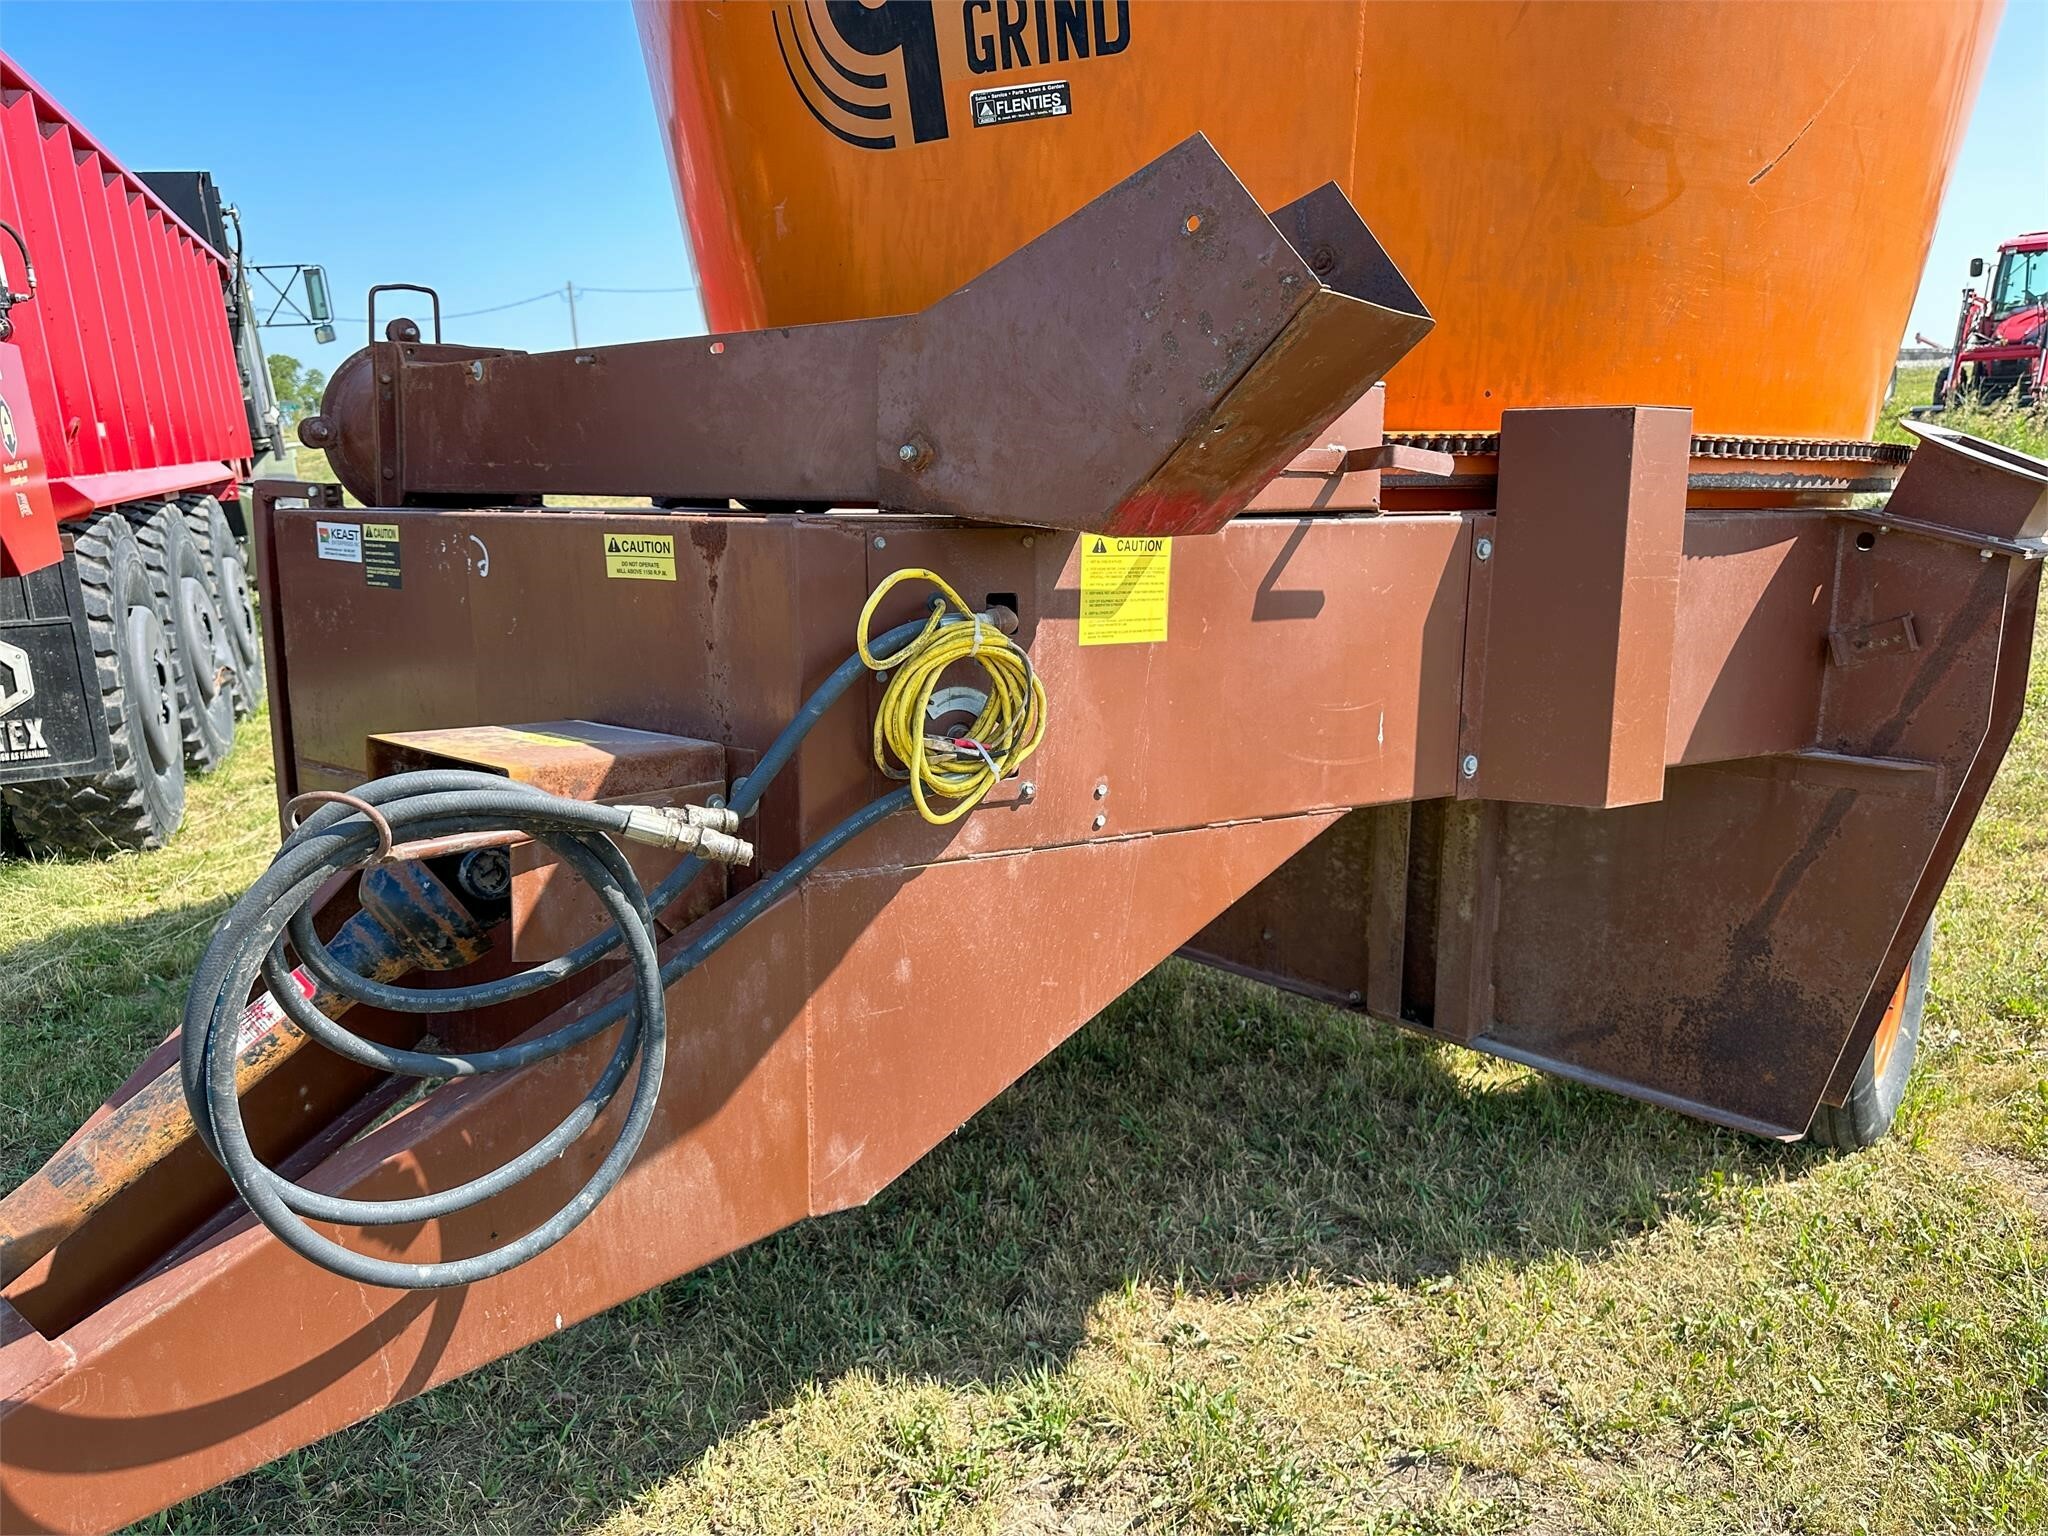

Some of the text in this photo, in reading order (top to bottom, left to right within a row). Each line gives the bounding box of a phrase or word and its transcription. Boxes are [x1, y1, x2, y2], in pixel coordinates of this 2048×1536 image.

[962, 0, 1131, 75] GRIND
[996, 92, 1062, 115] FLENTIES
[331, 528, 360, 541] KEAST
[373, 527, 397, 539] CAUTION
[621, 540, 671, 554] CAUTION
[1116, 539, 1163, 552] CAUTION
